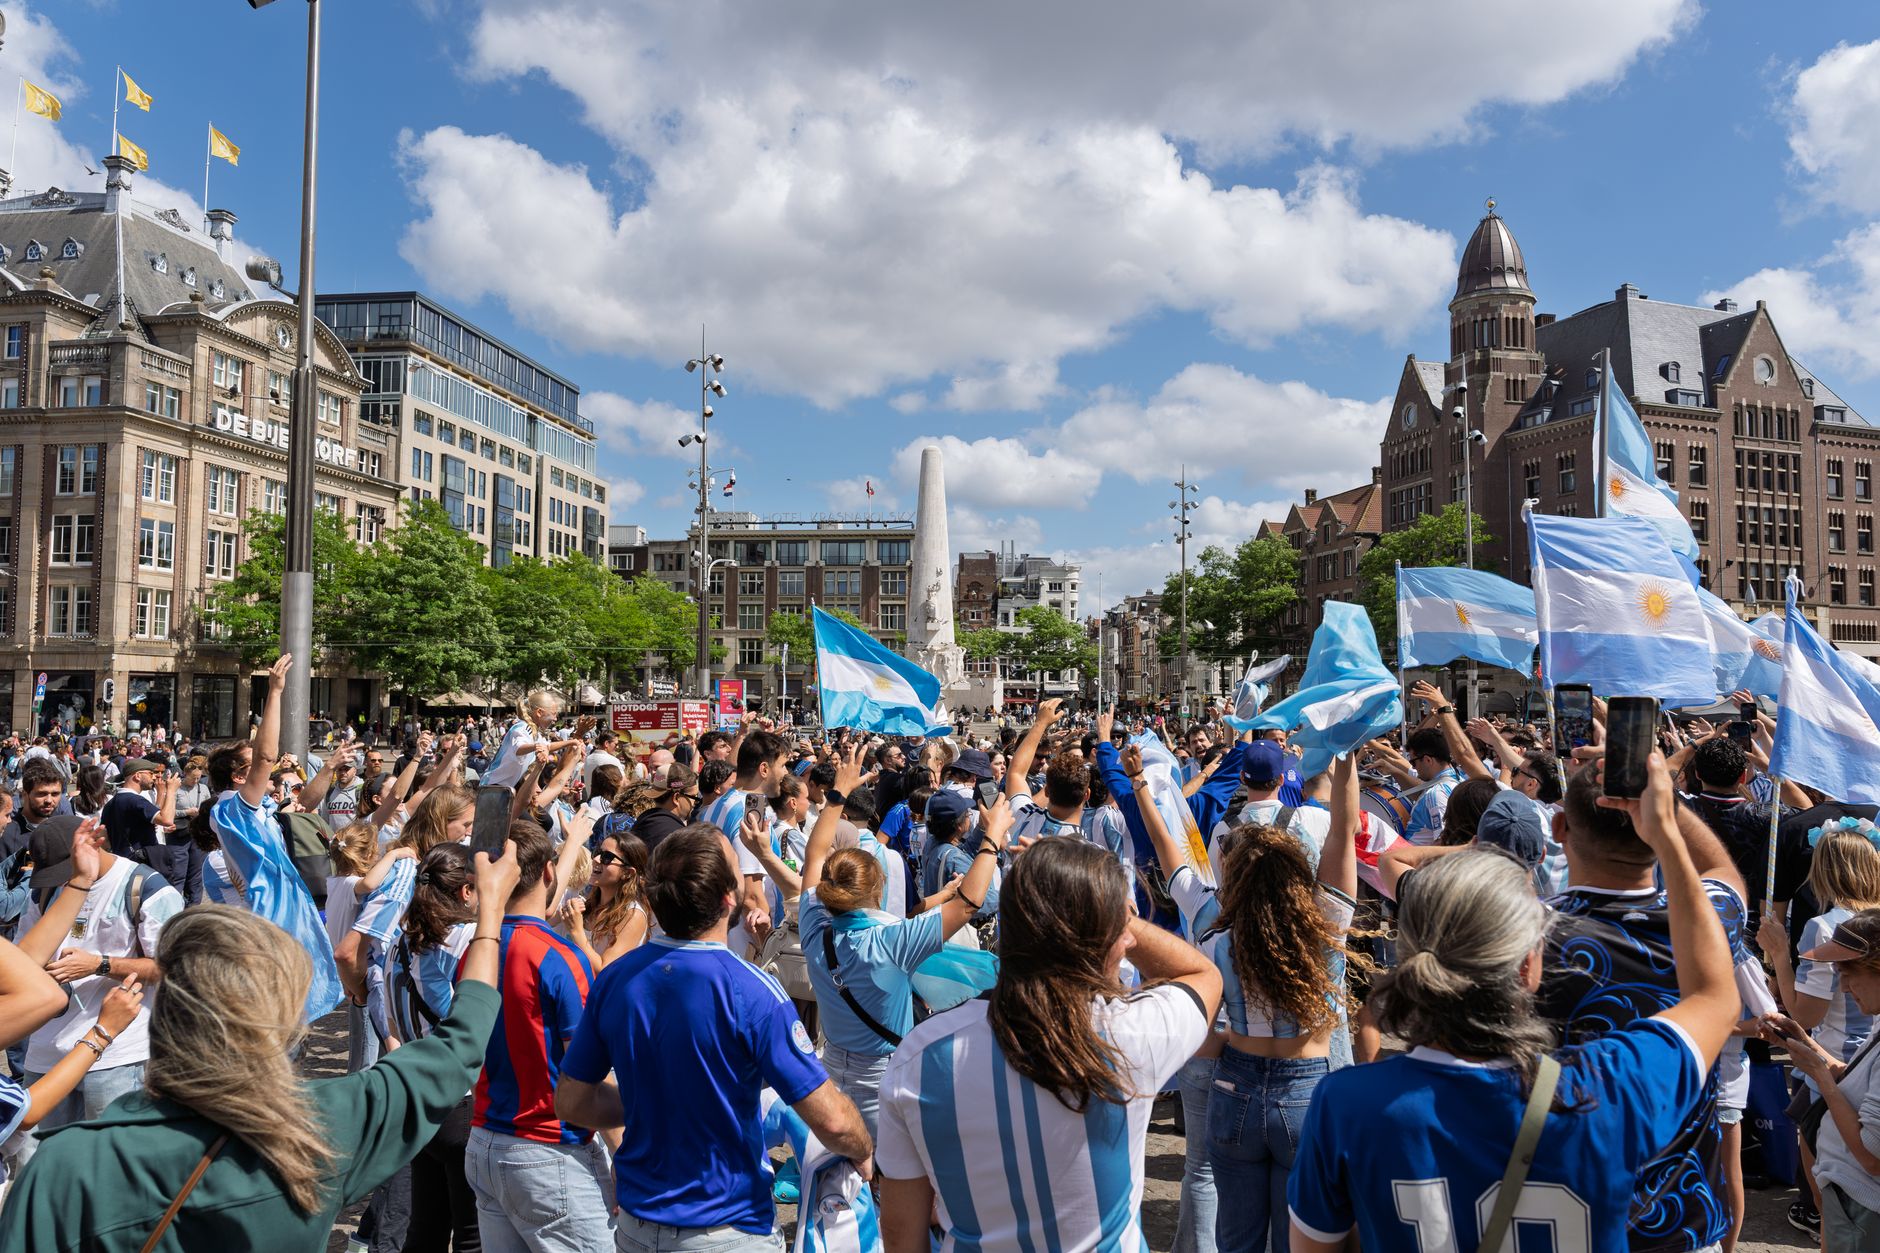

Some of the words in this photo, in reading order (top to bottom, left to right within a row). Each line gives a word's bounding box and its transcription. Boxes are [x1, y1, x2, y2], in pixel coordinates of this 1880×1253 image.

[216, 407, 249, 438] DE
[252, 418, 358, 468] BIJEORF
[763, 511, 804, 522] HOTEL
[613, 703, 658, 712] HOTDOGS
